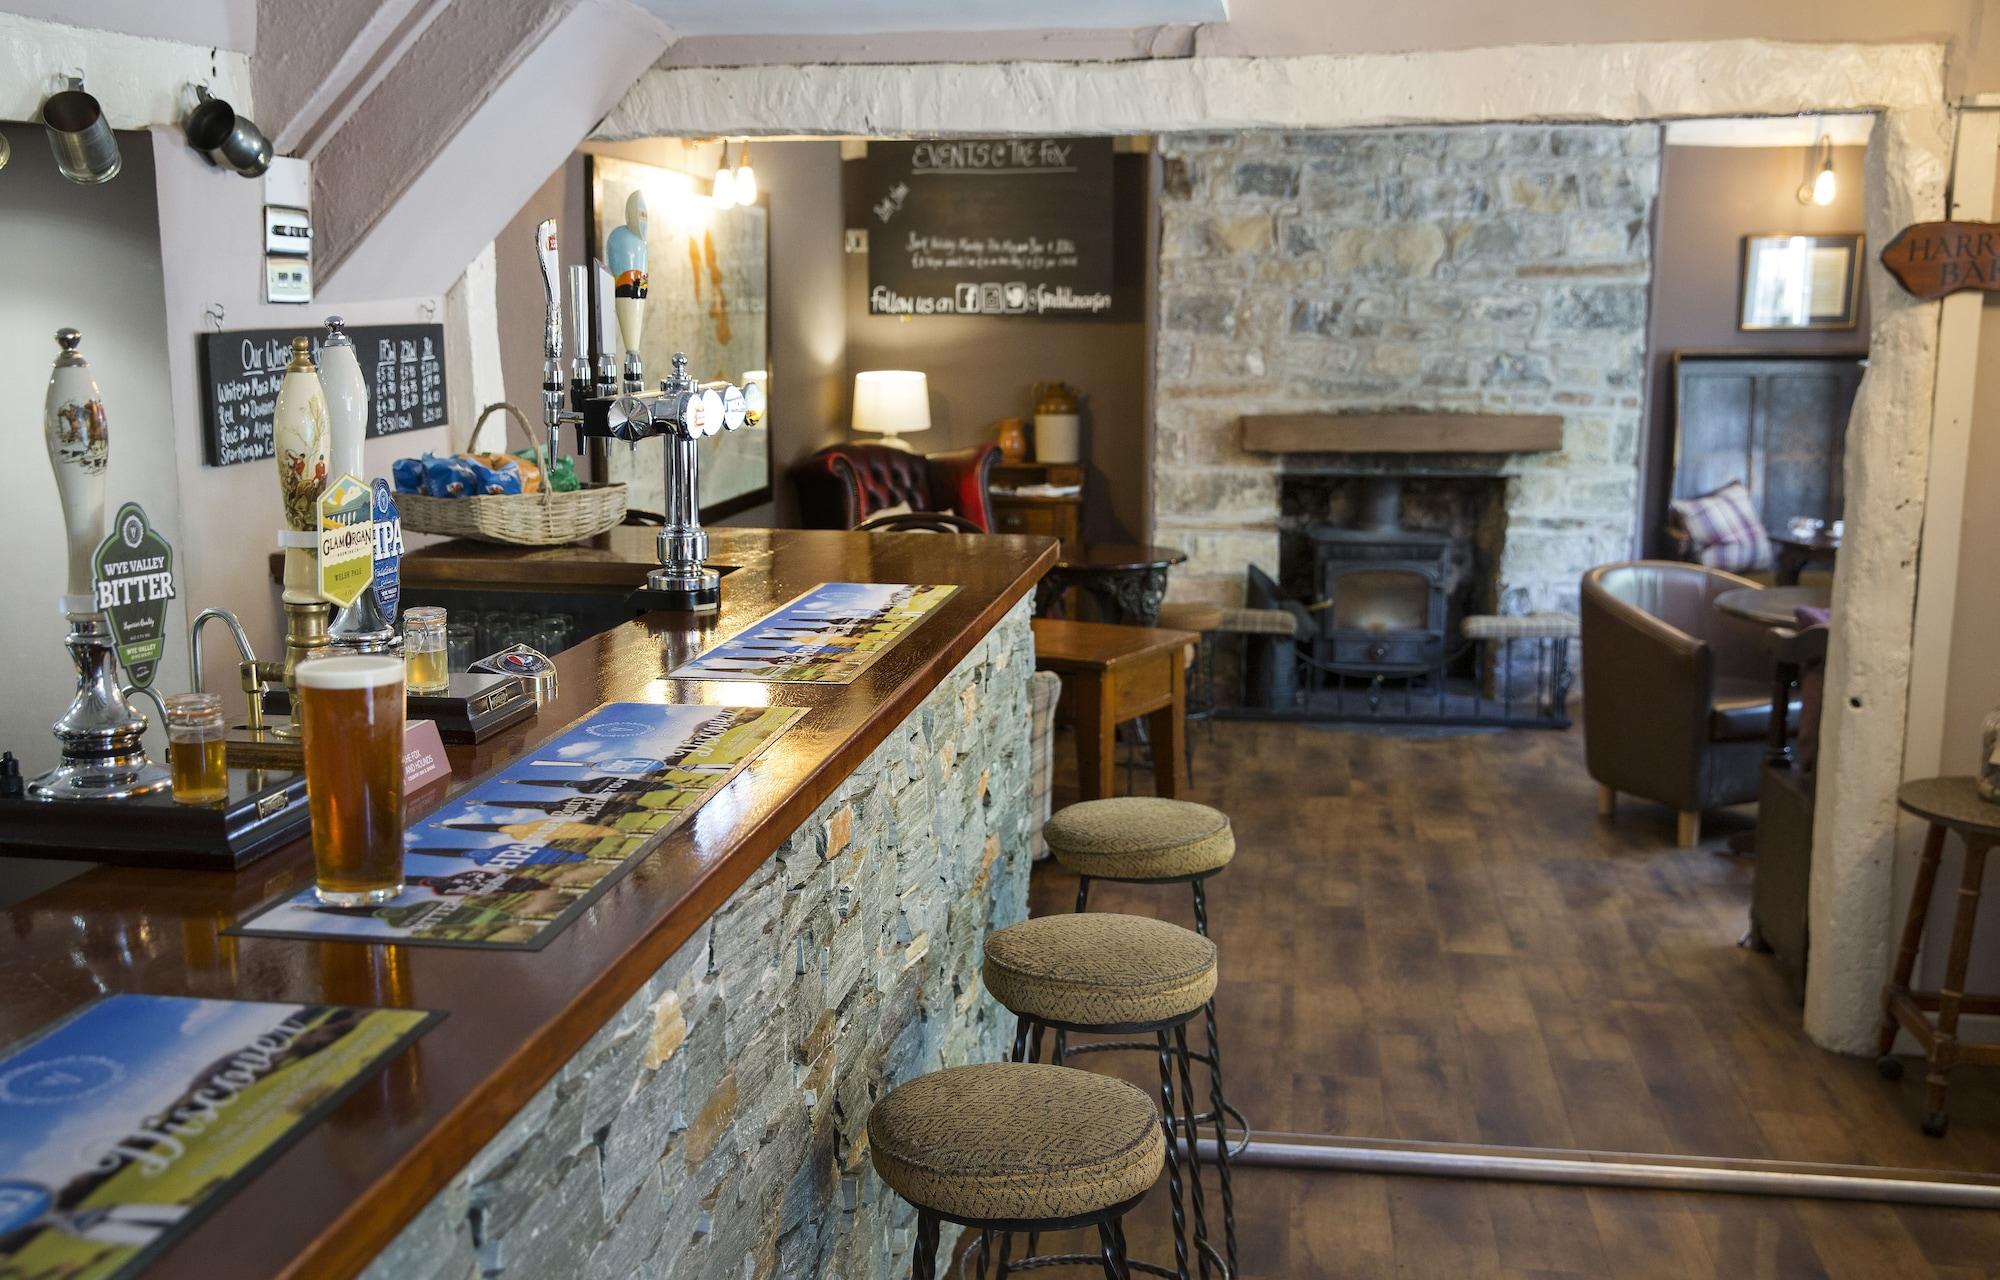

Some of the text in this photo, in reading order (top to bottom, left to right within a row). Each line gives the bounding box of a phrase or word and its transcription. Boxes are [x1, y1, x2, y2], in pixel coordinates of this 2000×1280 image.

[911, 141, 989, 168] EVENTS
[1909, 233, 1999, 262] HARR
[241, 338, 264, 371] Our
[265, 338, 293, 369] Wines
[323, 527, 372, 556] GLAMORGAN
[104, 556, 165, 576] WYE VALLEY
[98, 571, 176, 609] BITTER
[415, 754, 433, 769] HOUNDS
[480, 843, 540, 869] HPA
[77, 1018, 306, 1177] Discover
